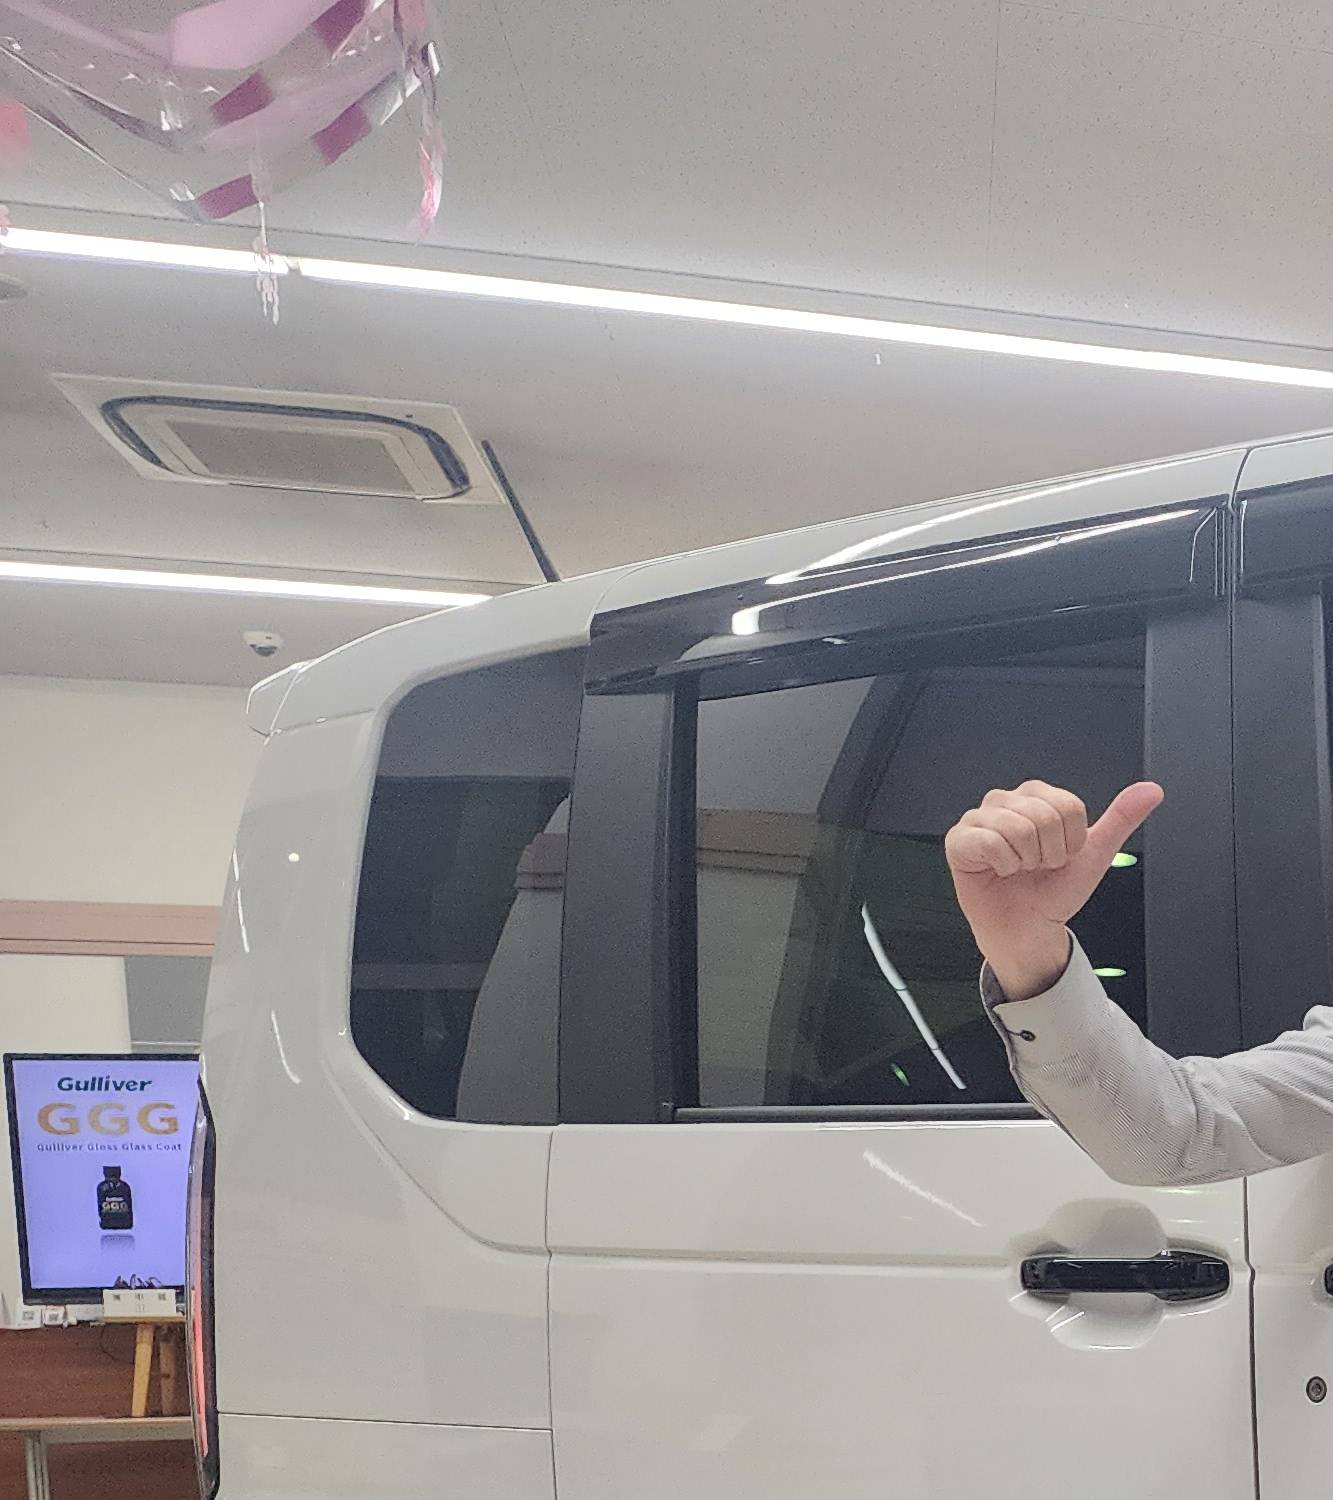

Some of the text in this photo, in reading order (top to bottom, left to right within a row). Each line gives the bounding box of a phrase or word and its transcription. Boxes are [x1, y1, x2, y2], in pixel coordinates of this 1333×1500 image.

[57, 1075, 153, 1092] Gulliver
[37, 1102, 179, 1136] GGG
[37, 1143, 82, 1151] Gulliver
